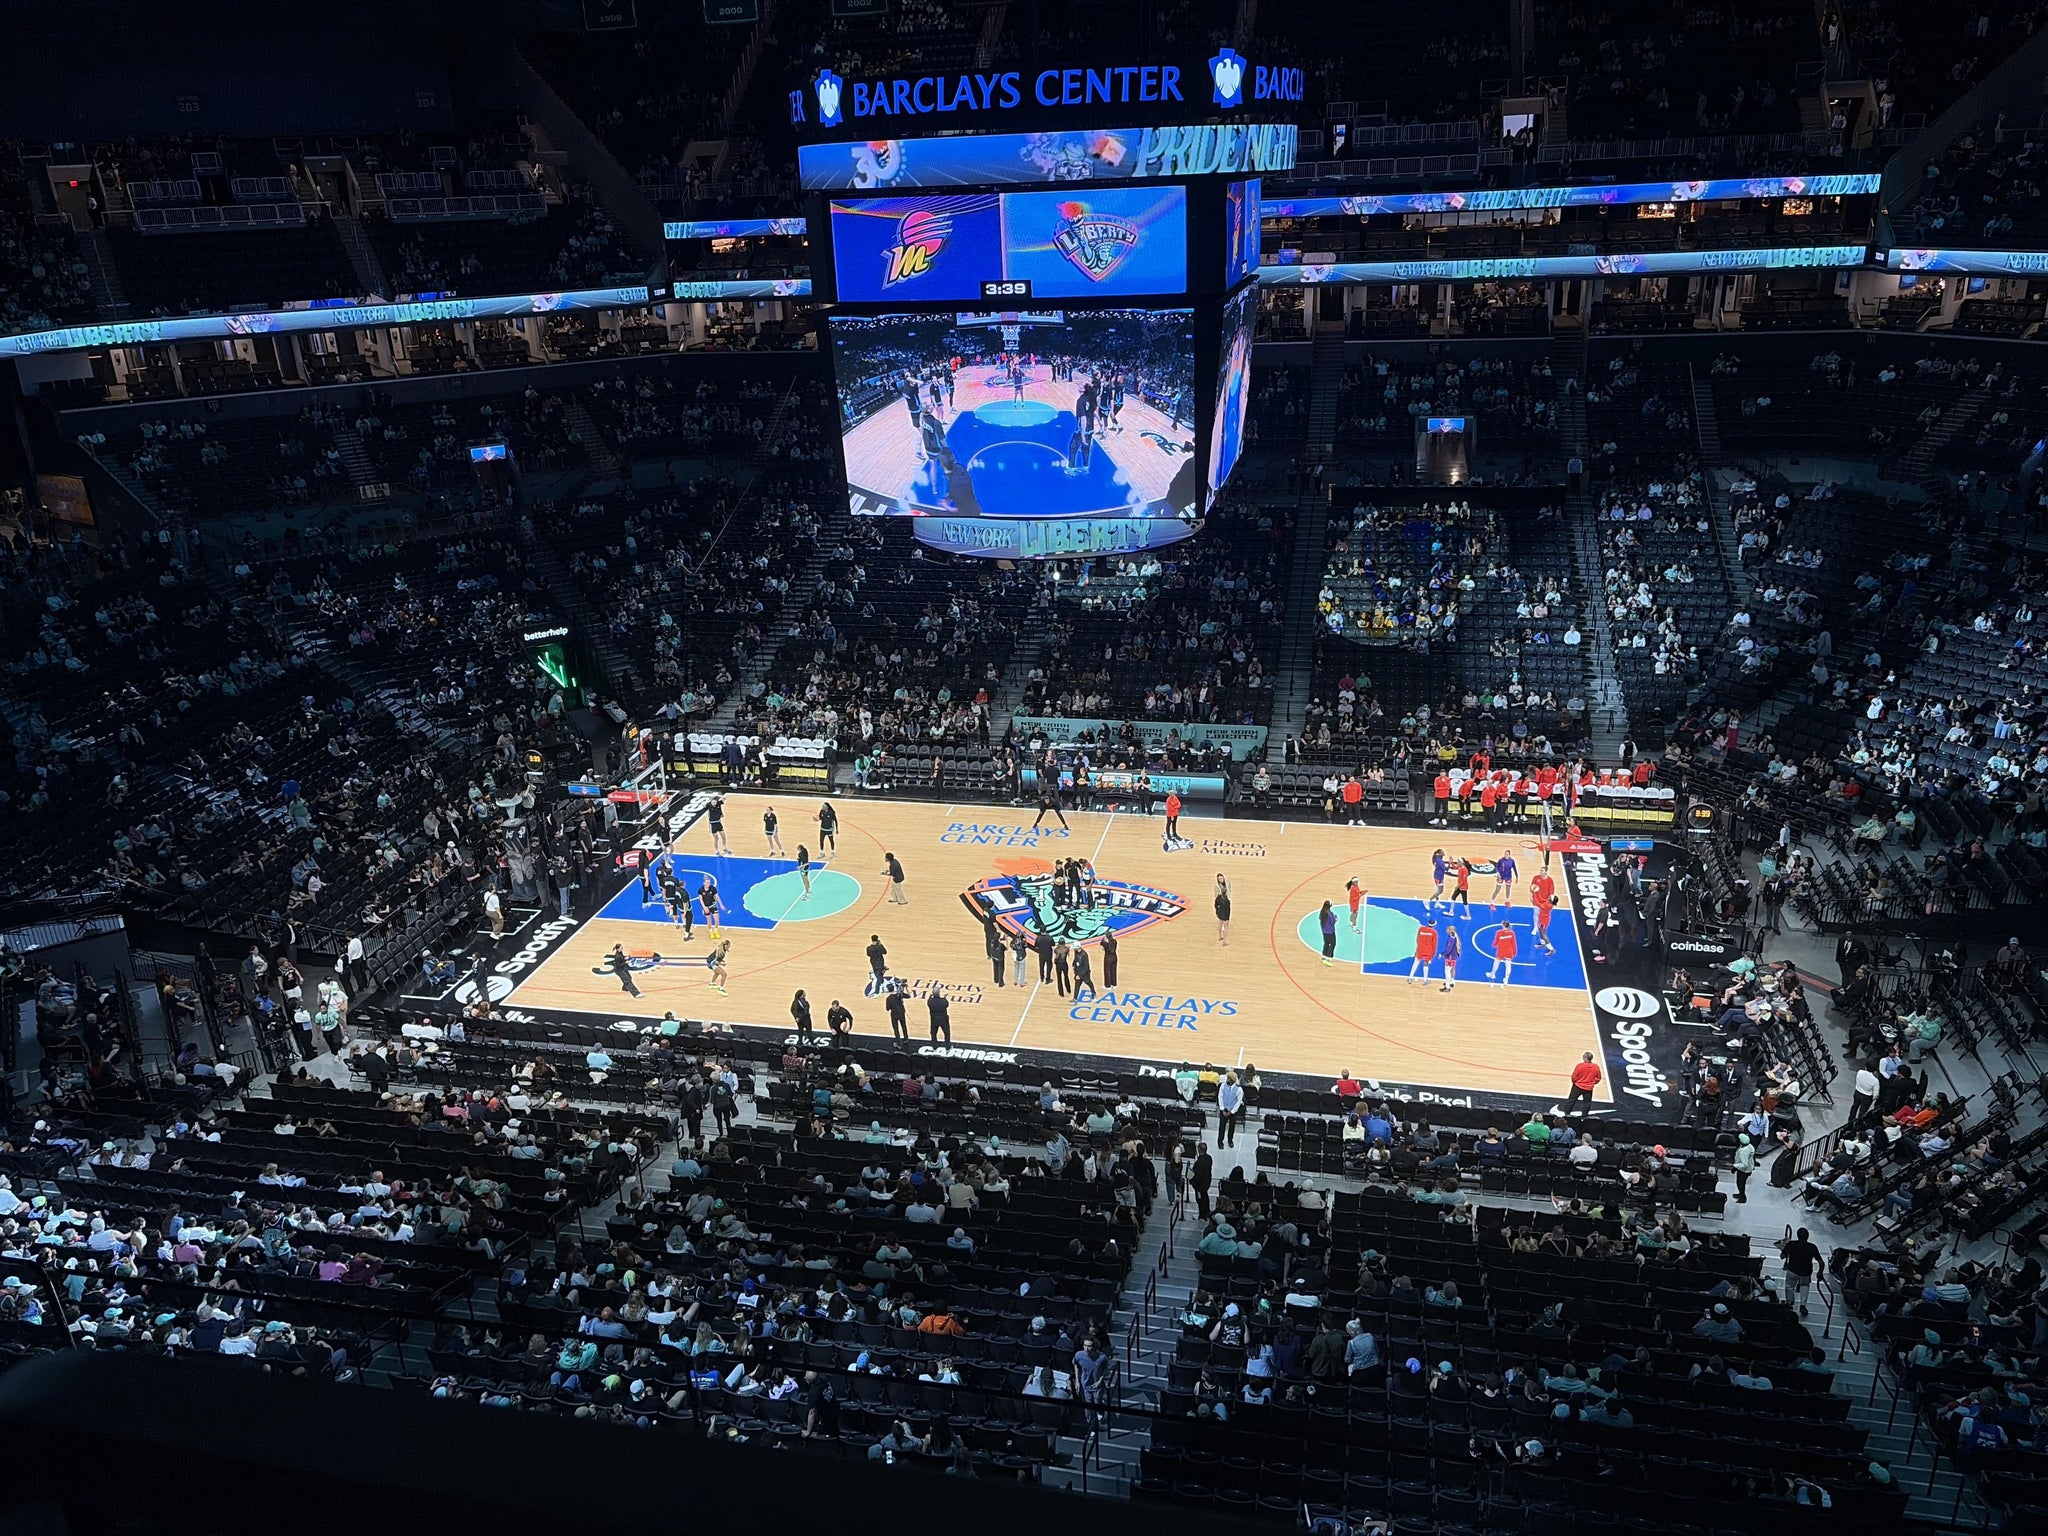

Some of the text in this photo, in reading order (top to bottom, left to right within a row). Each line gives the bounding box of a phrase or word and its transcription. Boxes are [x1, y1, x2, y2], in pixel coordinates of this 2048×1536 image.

[853, 65, 1184, 118] BARCLAYS CENTER
[1132, 125, 1242, 177] PRIDE
[1809, 176, 1861, 195] PRIDE
[1469, 190, 1516, 211] PRIDE
[1701, 252, 1729, 266] NEW
[1729, 251, 1760, 265] YORK
[1765, 246, 1864, 268] LIBERTY
[2005, 254, 2037, 269] NEW
[1393, 258, 1537, 278] NEW YORK LIBERTY
[985, 283, 1026, 295] 3:39
[332, 299, 474, 325] NEW YORK LIBERTY
[63, 322, 162, 347] LIBERTY
[942, 519, 1152, 557] NEW YORK LIBERTY
[524, 626, 568, 641] betterhelp
[1695, 809, 1711, 818] 3:39
[939, 832, 1038, 848] CENTER
[947, 823, 1072, 839] BARCLAYS
[1200, 846, 1267, 858] Mutual
[1202, 839, 1267, 852] Liberty
[1126, 883, 1179, 901] YORK
[494, 915, 579, 974] Spotify
[1670, 941, 1725, 953] coinbase
[1076, 989, 1239, 1016] BARCLAYS
[1069, 1006, 1198, 1031] CENTER
[1610, 1021, 1669, 1103] Spotify
[1419, 1091, 1472, 1109] Pixel
